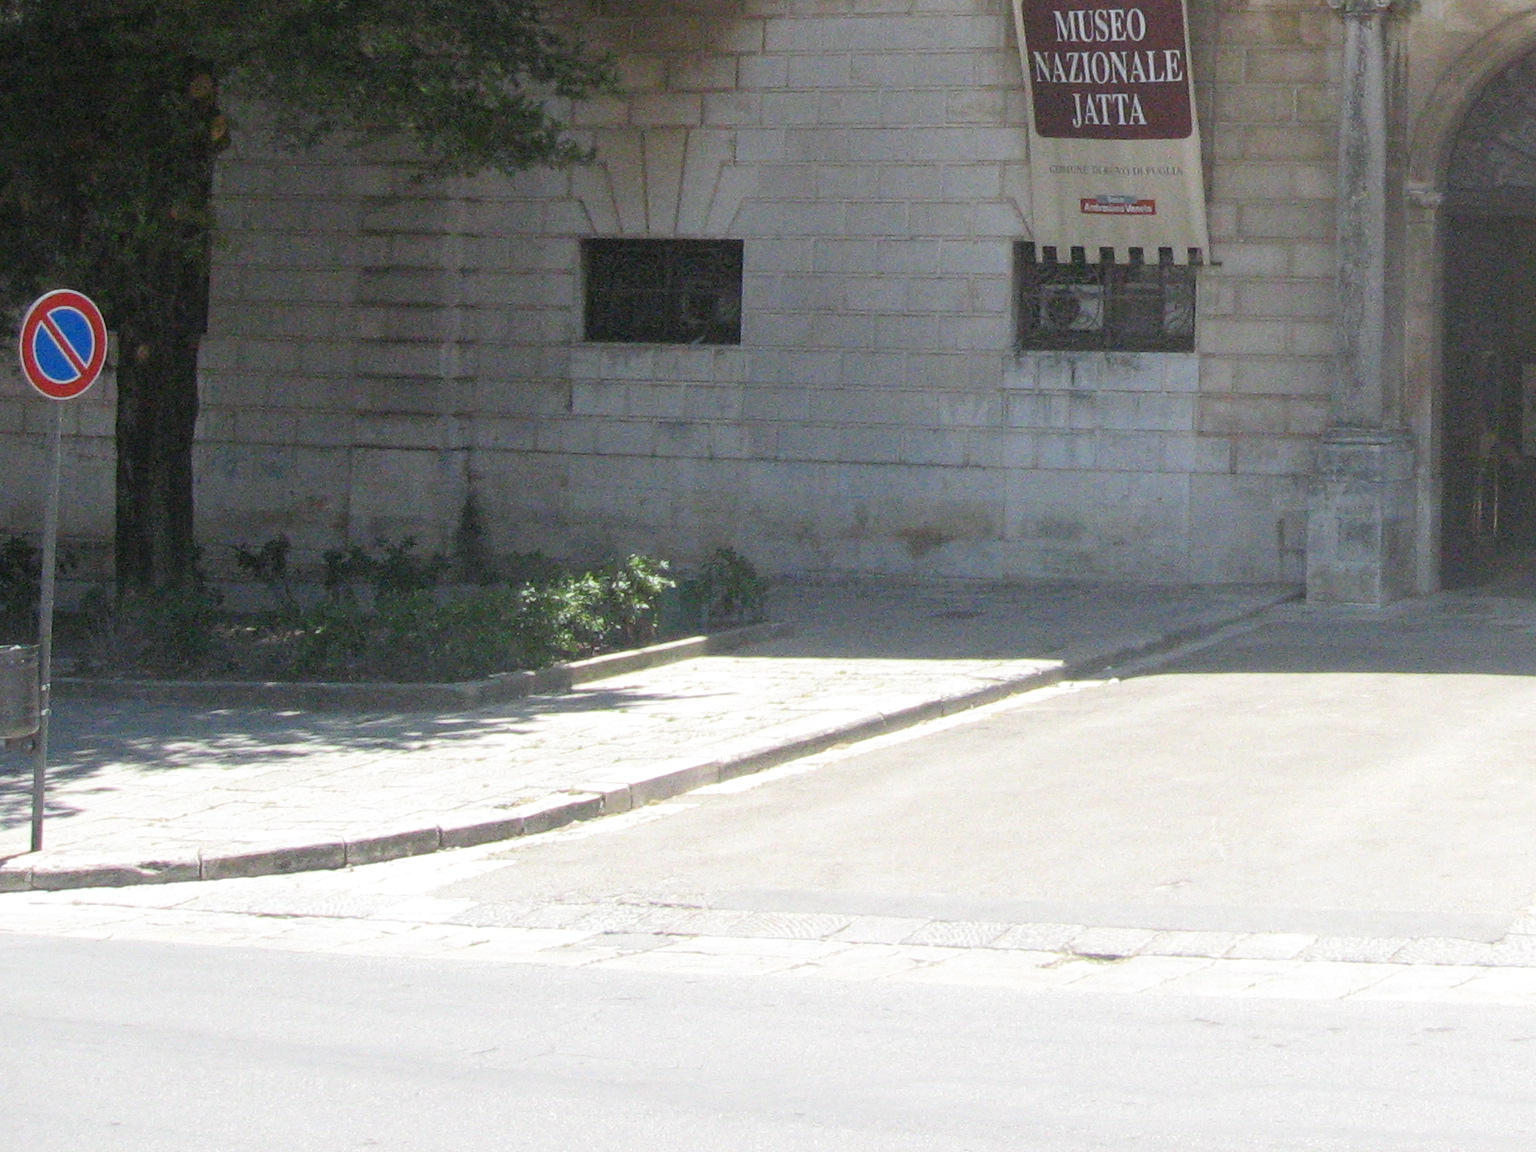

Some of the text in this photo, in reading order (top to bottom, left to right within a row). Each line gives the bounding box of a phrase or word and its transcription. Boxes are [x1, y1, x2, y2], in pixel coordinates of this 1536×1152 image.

[1053, 8, 1146, 42] MUSEO
[1033, 49, 1183, 84] NAZIONALE
[1072, 93, 1147, 128] JATTA
